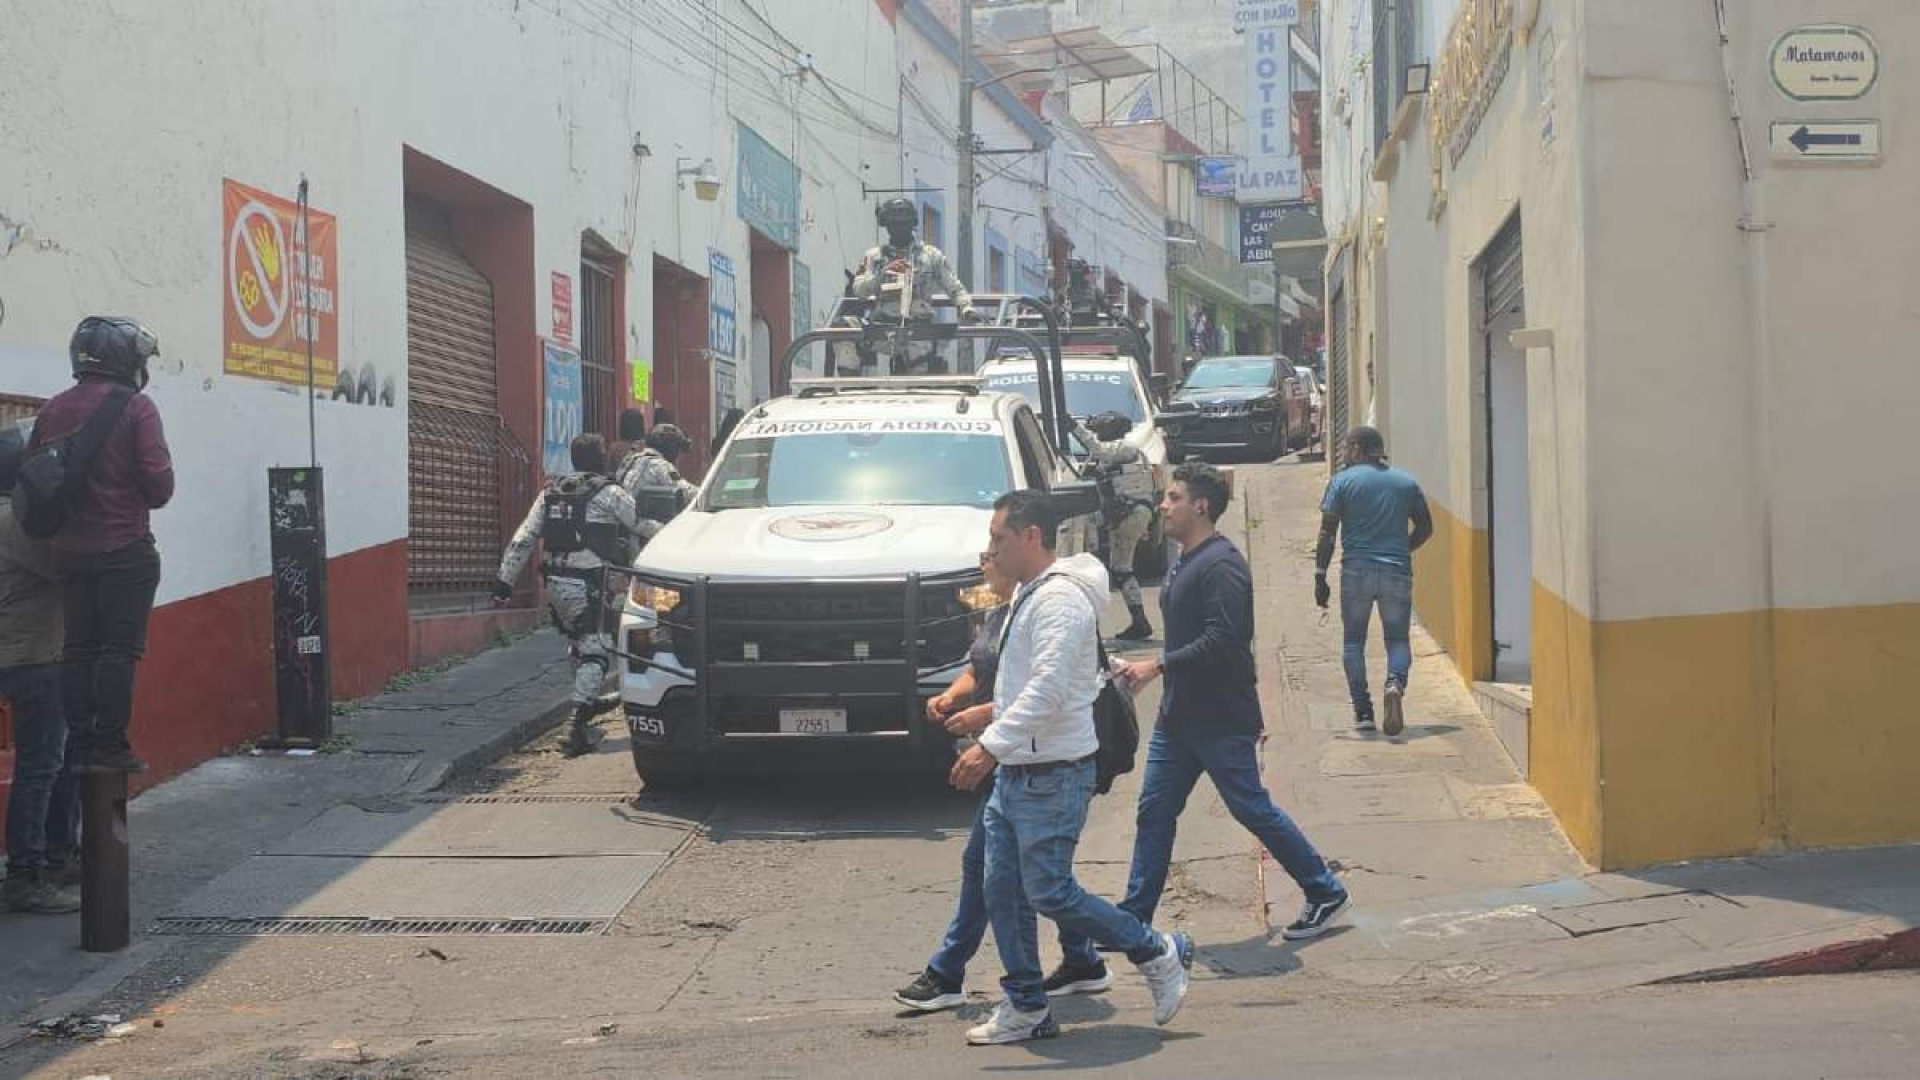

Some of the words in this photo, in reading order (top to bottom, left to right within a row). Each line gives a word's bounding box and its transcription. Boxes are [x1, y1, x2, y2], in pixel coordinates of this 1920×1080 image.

[1786, 45, 1865, 62] Matamoros
[1256, 32, 1277, 154] HOTEL
[1240, 172, 1260, 188] LA
[1264, 169, 1298, 188] PAZ
[989, 374, 1038, 388] POLIC
